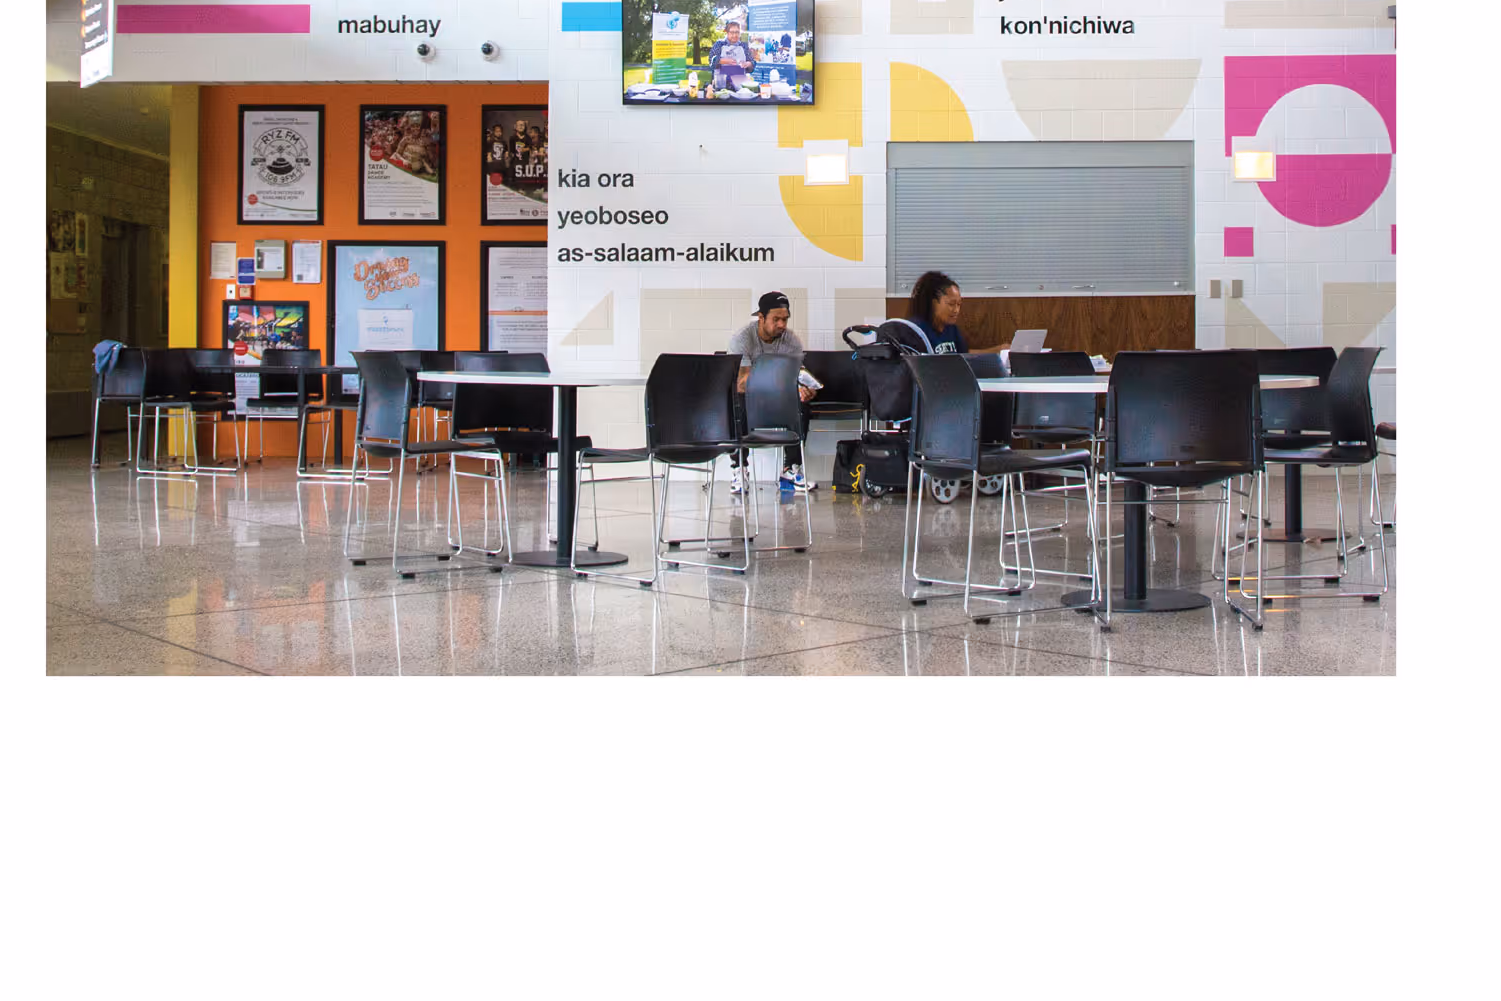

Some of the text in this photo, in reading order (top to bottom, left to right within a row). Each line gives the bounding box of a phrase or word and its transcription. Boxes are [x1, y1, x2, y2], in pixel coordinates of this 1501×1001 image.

[337, 14, 442, 36] mabuhay
[1000, 15, 1136, 35] kon'nichiwa
[558, 168, 635, 188] kia ora
[557, 206, 669, 230] yeoboseo
[557, 242, 775, 263] as-salaam-alaikum
